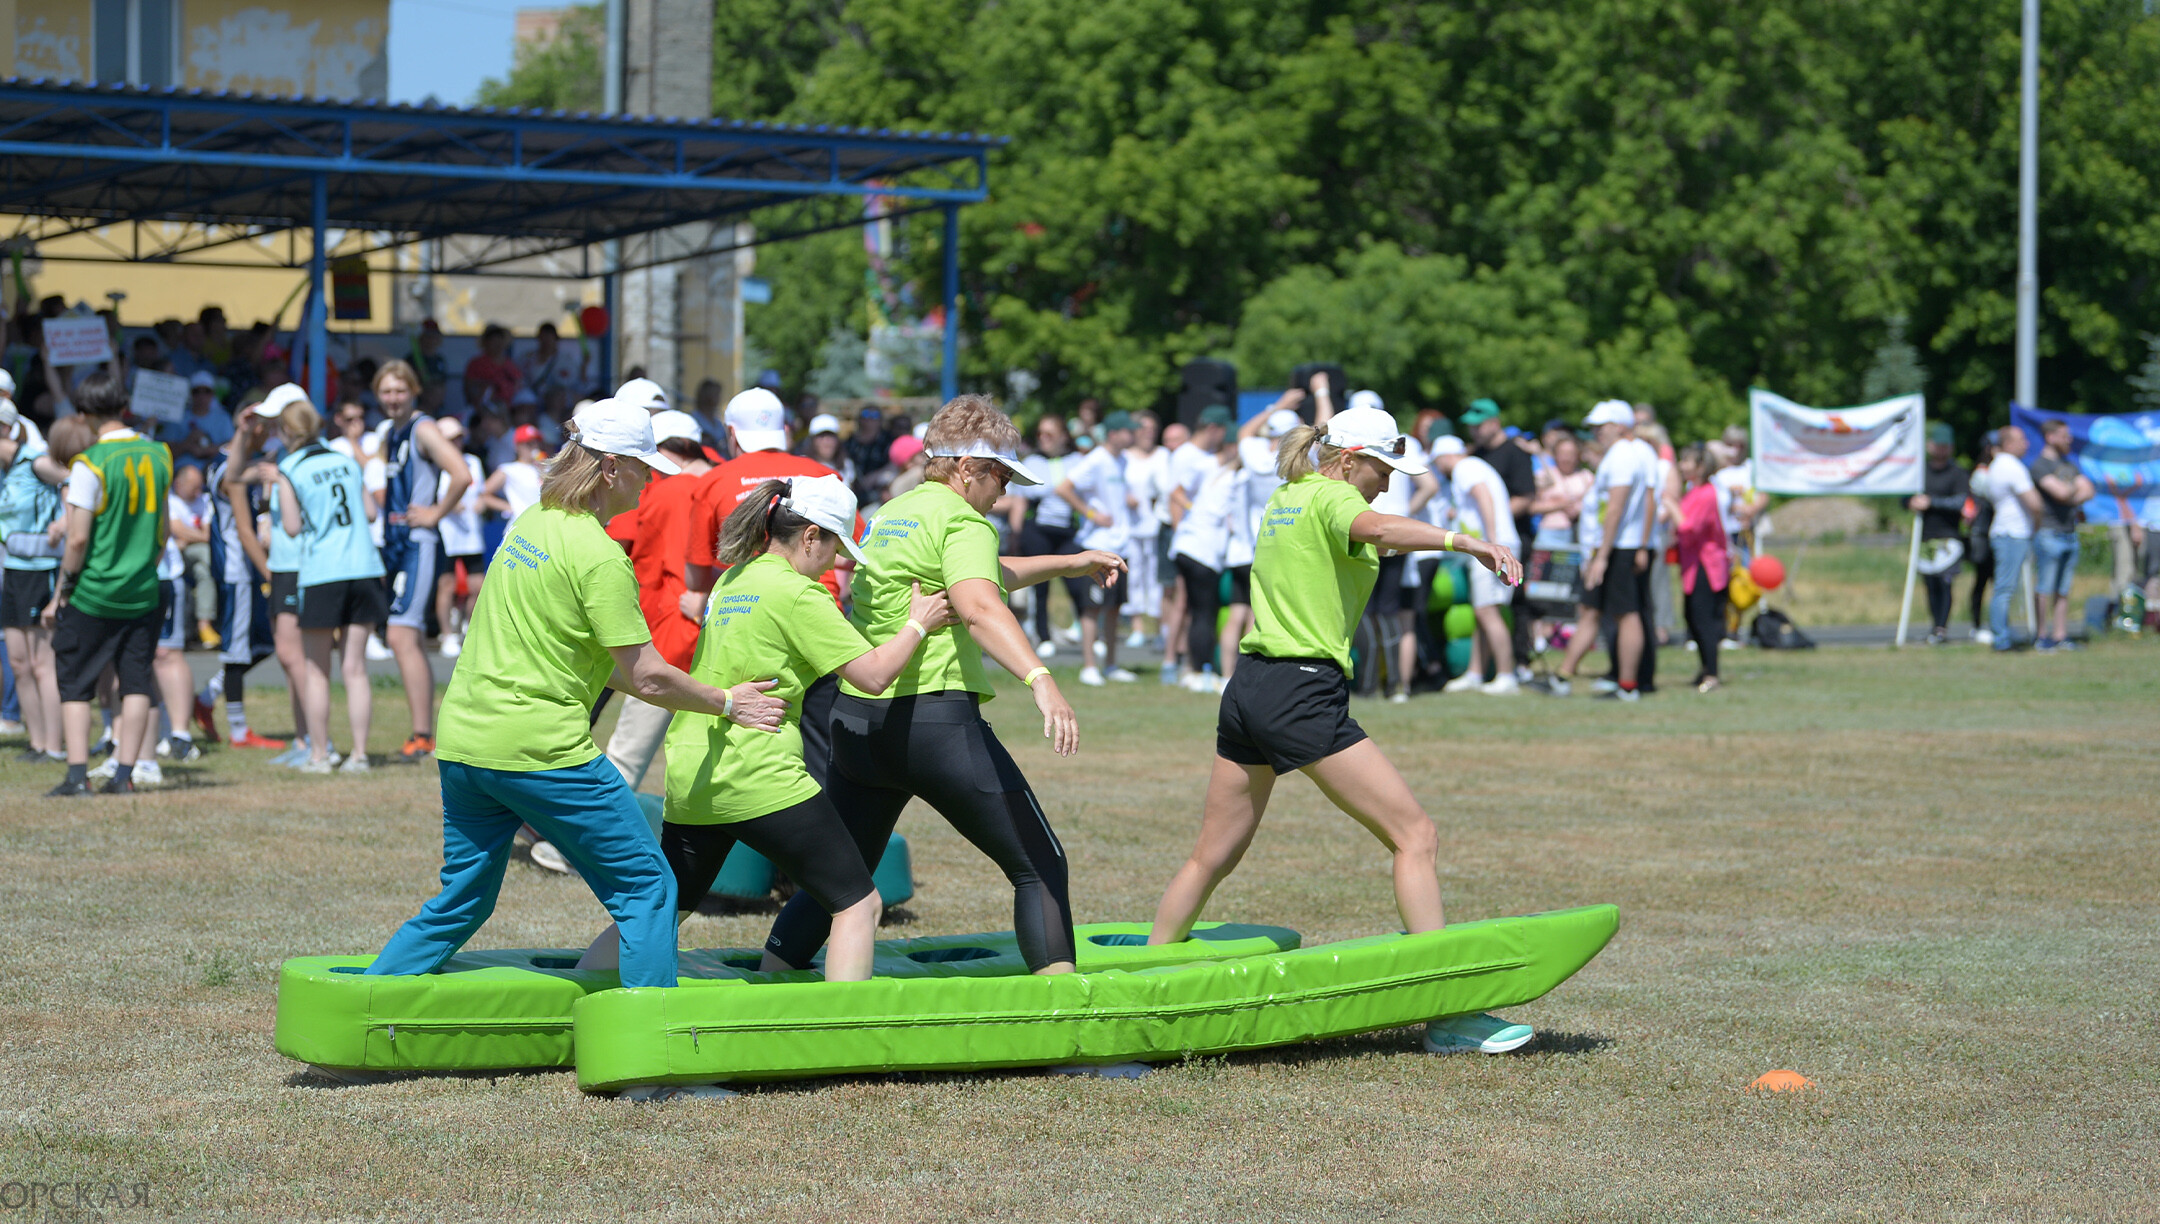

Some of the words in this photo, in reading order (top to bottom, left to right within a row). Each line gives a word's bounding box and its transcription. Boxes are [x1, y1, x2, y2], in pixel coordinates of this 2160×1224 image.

[124, 454, 157, 515] 11
[331, 483, 352, 527] 3
[882, 519, 919, 529] ГОРОДСКАЯ
[877, 529, 909, 538] БОЛЬНИЦА
[512, 534, 550, 563] ГОРОДСКАЯ
[505, 545, 538, 571] БОЛЬНИЦА
[503, 559, 517, 571] ГАЯ
[721, 594, 760, 604] ГОРОДСКАЯ
[718, 605, 752, 615] БОЛЬНИЦА
